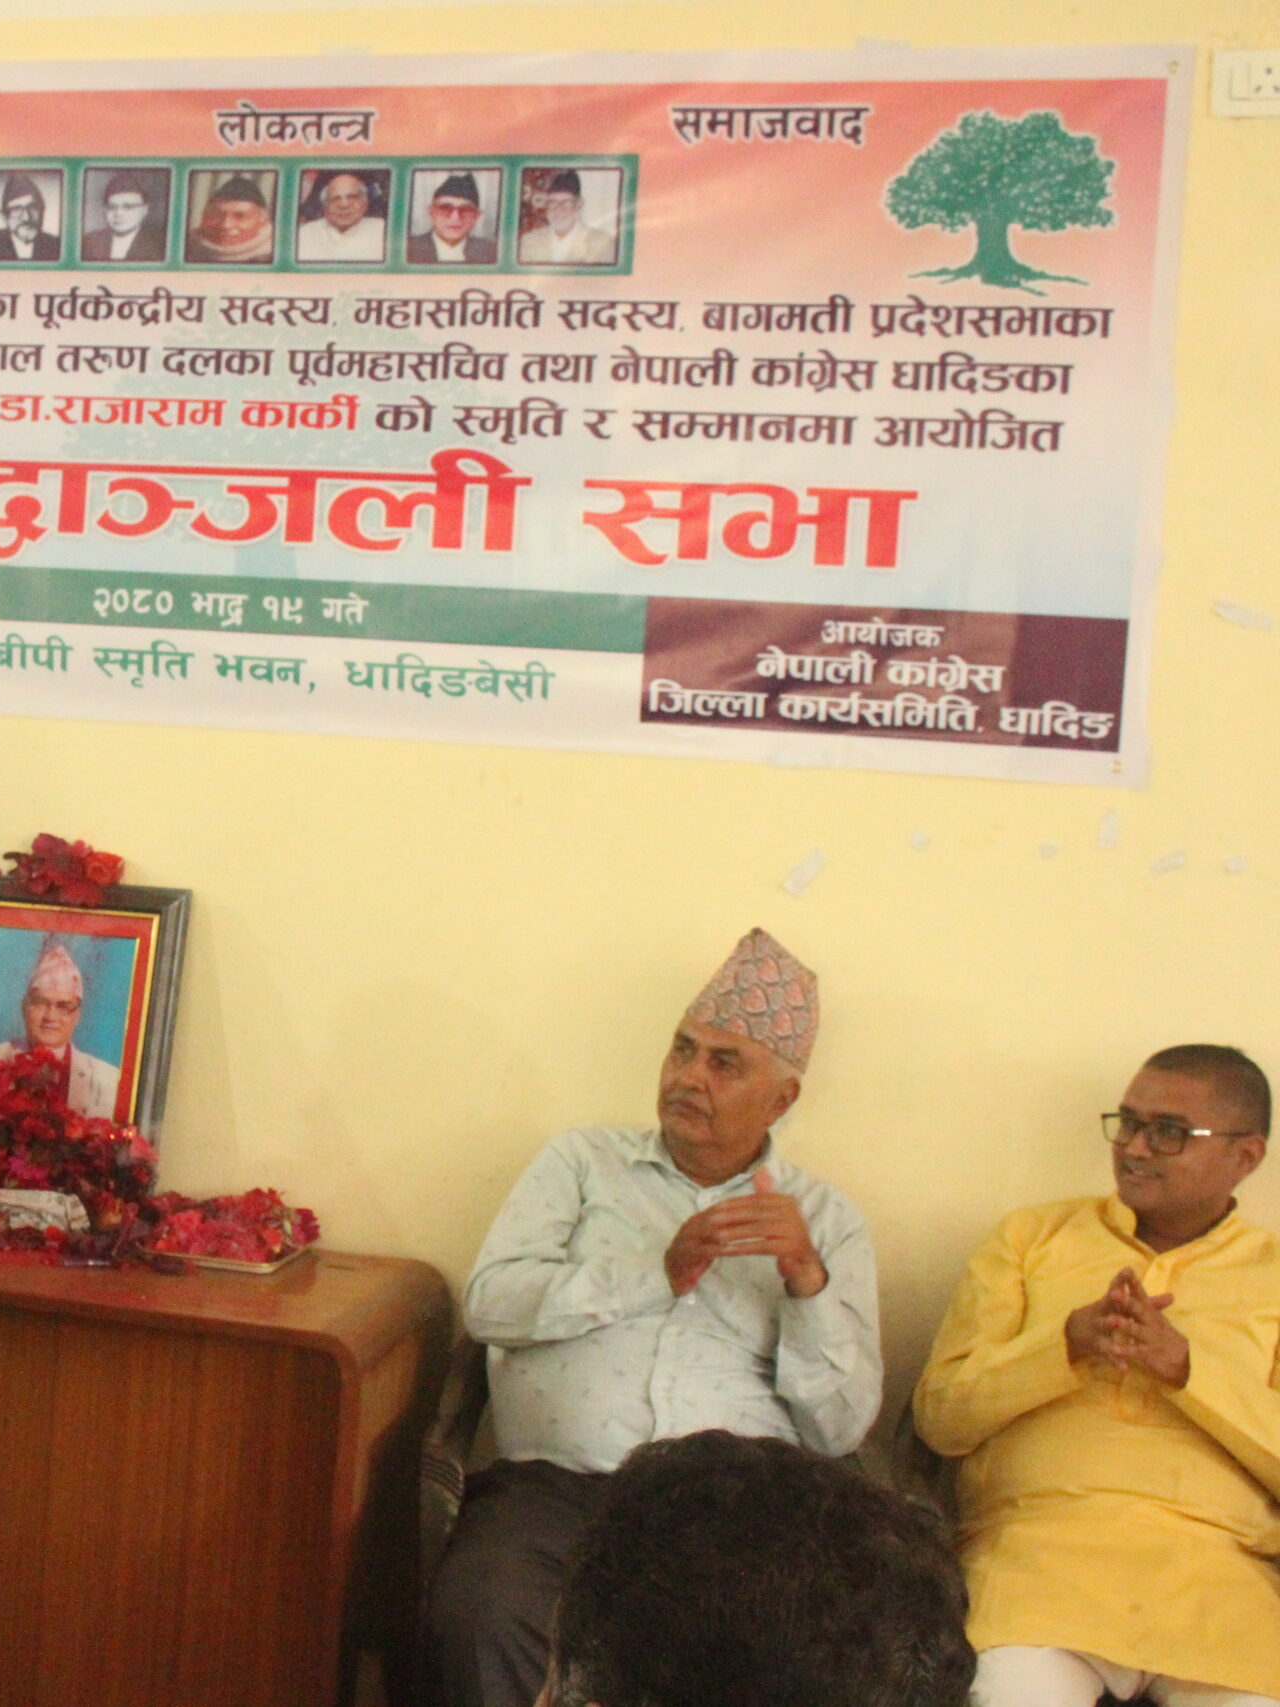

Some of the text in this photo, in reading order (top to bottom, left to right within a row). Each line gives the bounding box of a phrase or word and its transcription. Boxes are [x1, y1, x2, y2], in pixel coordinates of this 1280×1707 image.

[216, 102, 375, 146] लोकतन्त्र
[671, 106, 870, 145] समाजवाद
[33, 285, 206, 330] पूर्वकेन्द्रीय
[353, 289, 544, 329] महासमिति
[702, 294, 855, 334] बागमती
[870, 294, 1114, 340] प्रदेशसभाका
[162, 346, 274, 378] दलका
[288, 342, 508, 387] पूर्वमहासचिव
[521, 353, 598, 385] तथा
[610, 345, 738, 388] नेपाली
[751, 349, 878, 393] कांग्रेस
[241, 393, 360, 431] कार्की
[375, 395, 437, 432] को
[452, 396, 568, 445] स्मृति
[583, 408, 618, 440] र
[631, 410, 858, 445] सम्मानमा
[873, 409, 1065, 452] आयोजित
[582, 479, 919, 567] सभा
[93, 588, 370, 627] २०८० भाद्र १९ गते
[821, 617, 945, 650] आयोजक
[93, 639, 195, 688] स्मृति
[214, 653, 317, 694] भवन,
[345, 653, 557, 702] धादिङबेसी
[756, 645, 1007, 694] नेपाली कांग्रेस
[648, 678, 770, 719] जिल्ला
